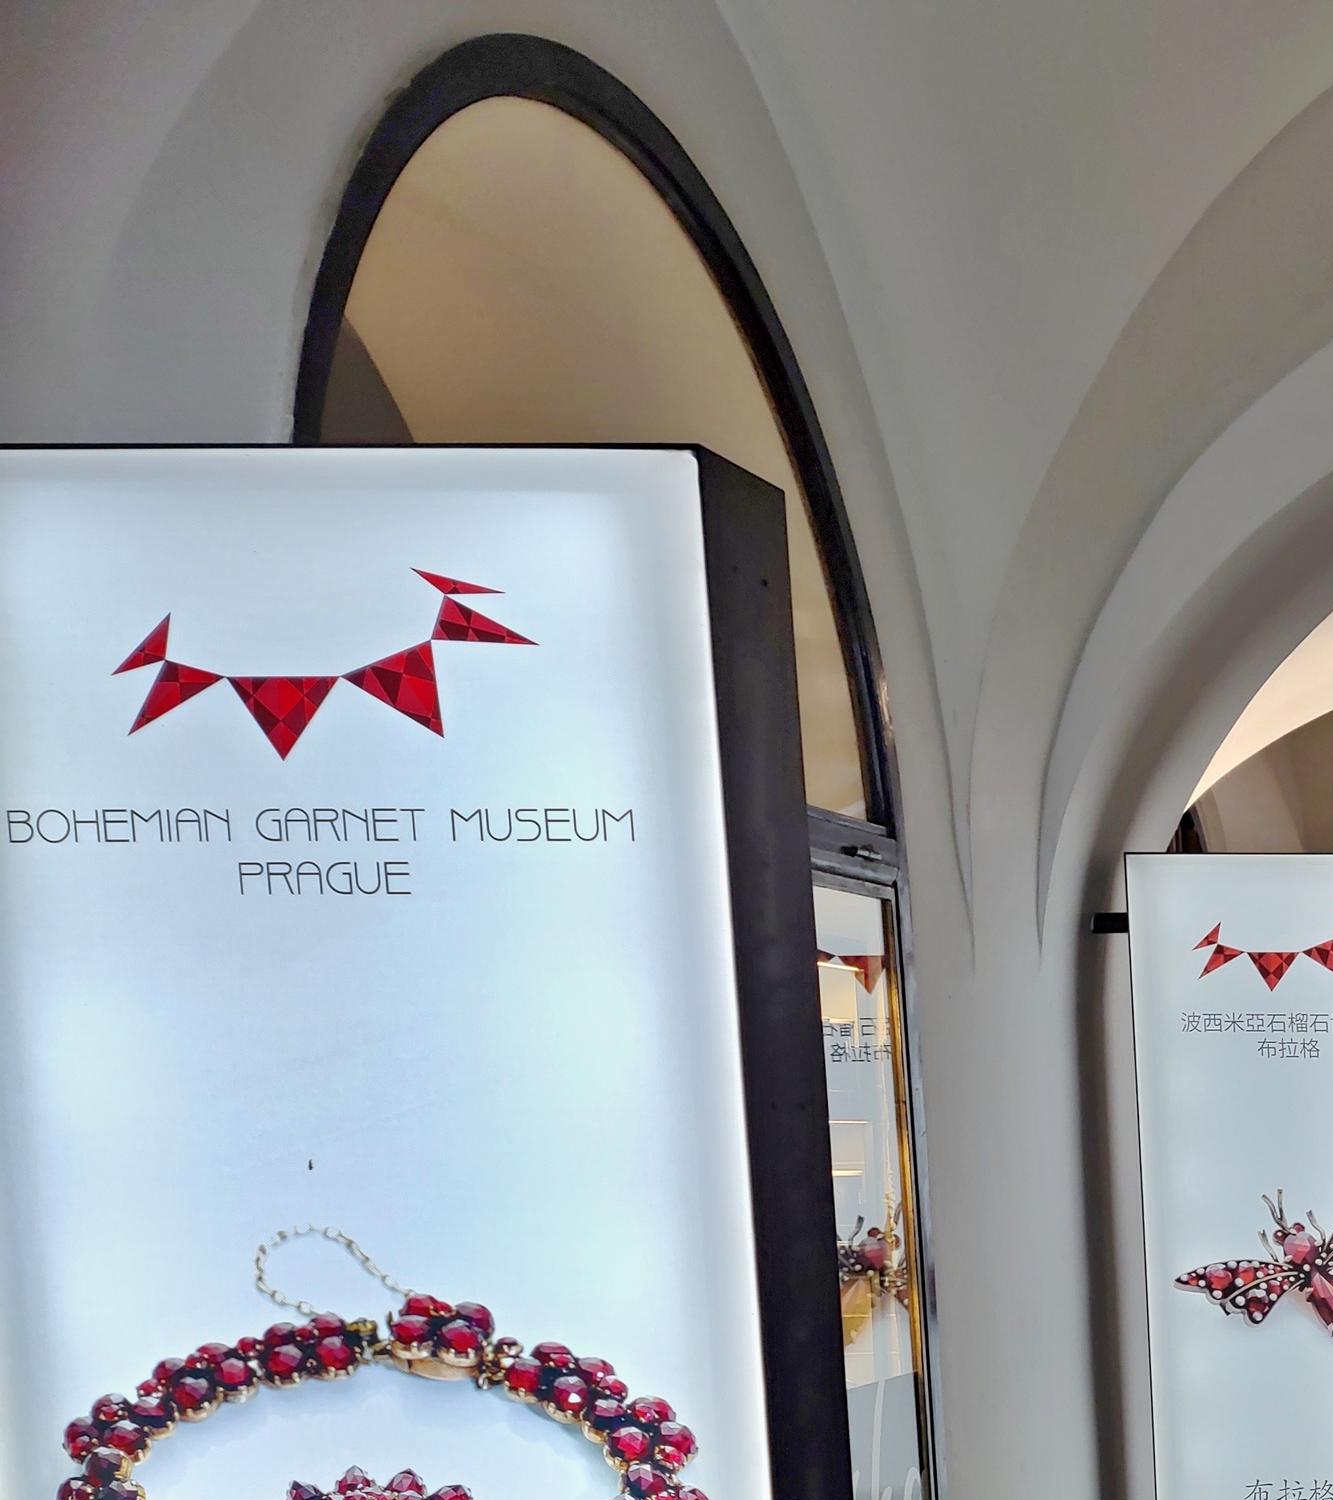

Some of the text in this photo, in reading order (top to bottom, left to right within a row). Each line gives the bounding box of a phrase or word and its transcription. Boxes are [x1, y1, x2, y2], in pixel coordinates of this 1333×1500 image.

[7, 807, 636, 843] BOHEMIAN GARNET MUSEUM
[238, 860, 411, 894] PRAGUE
[1257, 1038, 1320, 1059] 布拉格
